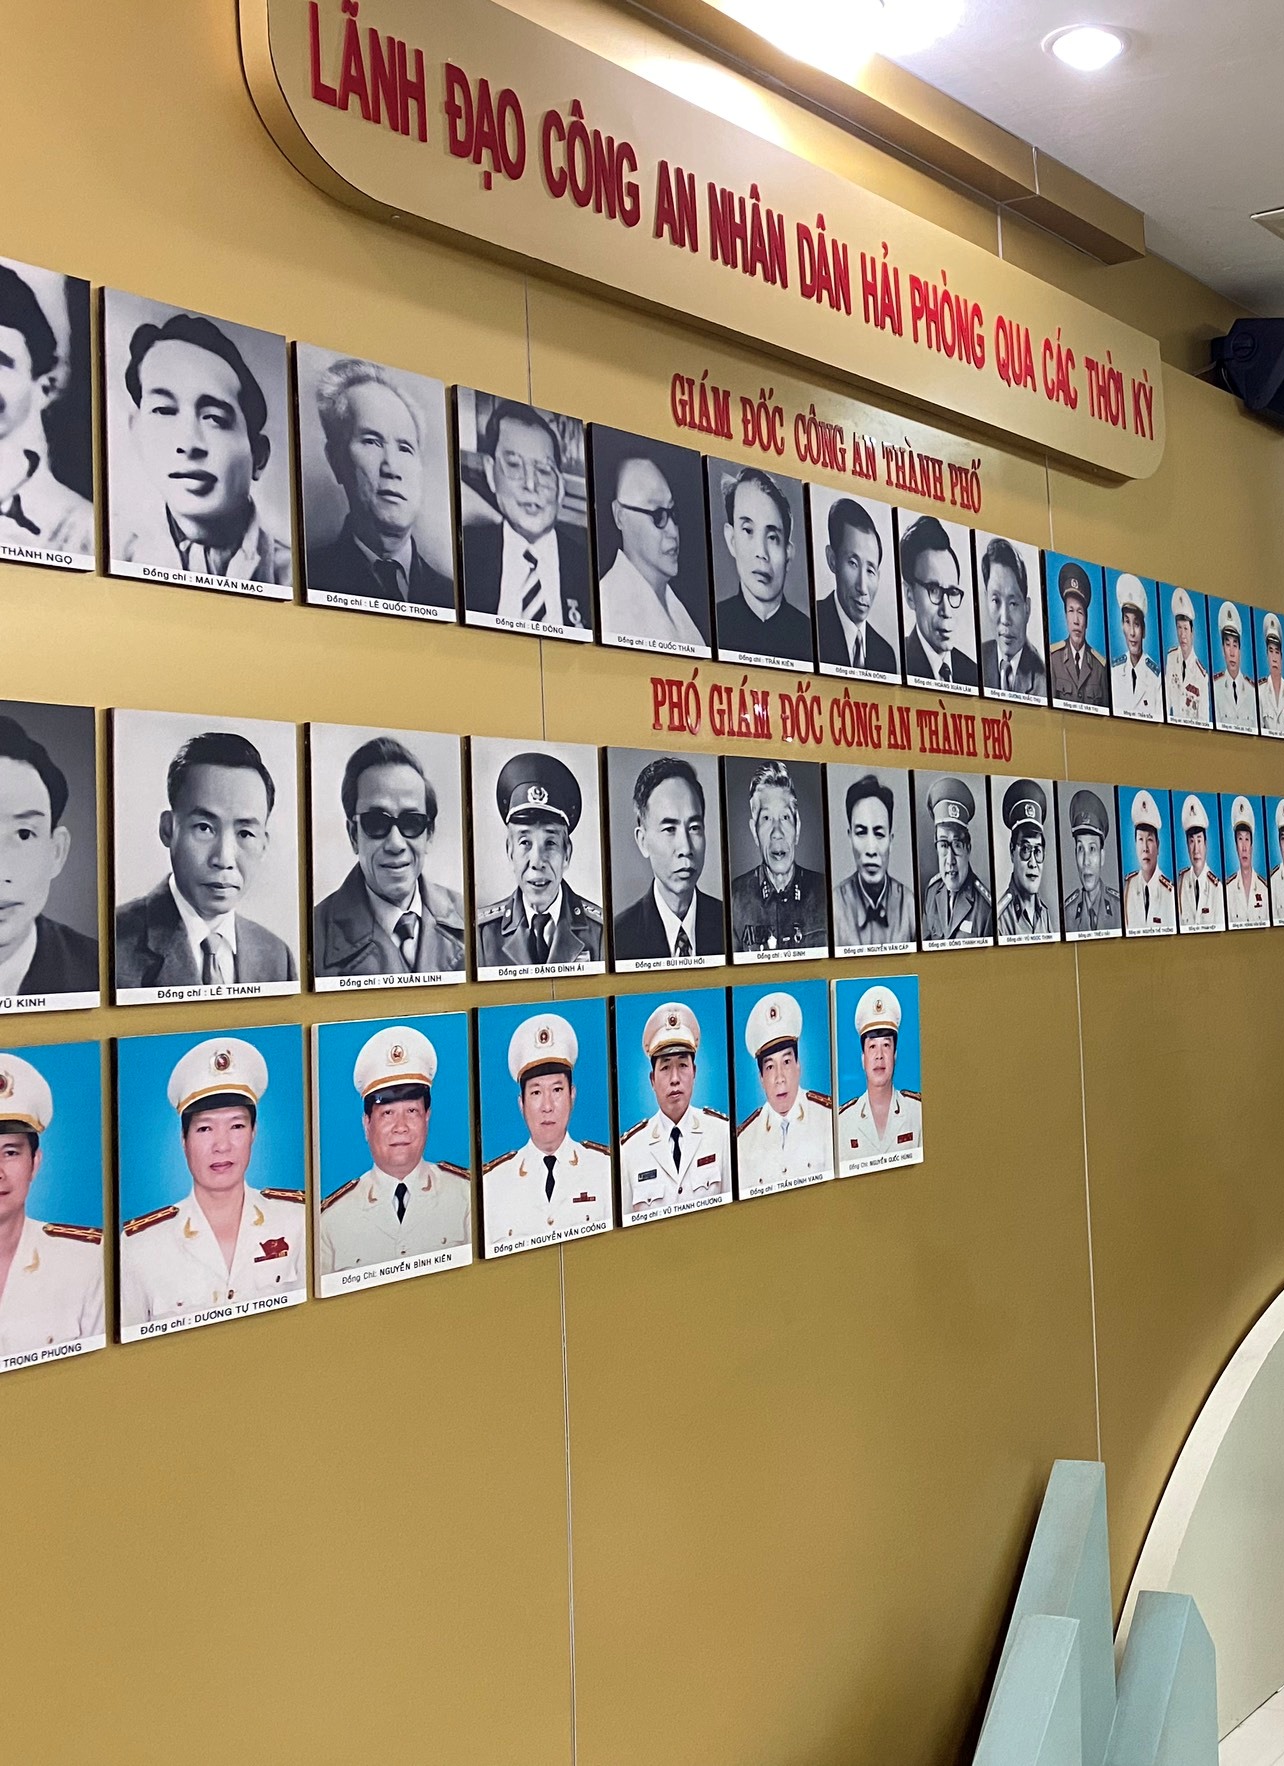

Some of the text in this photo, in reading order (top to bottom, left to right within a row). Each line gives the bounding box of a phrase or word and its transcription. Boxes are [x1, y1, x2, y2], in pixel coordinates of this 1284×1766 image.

[308, 0, 1154, 441] LÃNH ĐẠO CÔNG AN NHÂN DÂN HẢI PHÒNG QUA CÁC THỜI KỲ
[670, 369, 982, 514] GIÁM ĐỐC CÔNG AN THÀNH PHỐ
[1, 545, 42, 560] THÀNH
[195, 575, 214, 585] MAI
[216, 577, 238, 589] VĂN
[241, 582, 263, 593] MẠC
[369, 599, 379, 609] LÊ
[382, 600, 407, 613] QUỐC
[409, 605, 438, 617] TRỌNG
[531, 622, 540, 631] LÊ
[648, 639, 656, 648] LÊ
[650, 667, 1013, 762] PHÓ GIÁM ĐỐC CÔNG AN THÀNH PHỐ
[557, 964, 575, 973] ĐÌNH
[382, 975, 395, 984] VŨ
[397, 975, 421, 984] XUÂN
[423, 974, 442, 983] LINH
[210, 986, 222, 996] LÊ
[227, 985, 261, 995] THANH
[17, 997, 46, 1008] KINH
[662, 1206, 672, 1215] VŨ
[673, 1202, 695, 1212] THANH
[530, 1230, 562, 1245] NGUYỄN
[563, 1228, 579, 1238] VĂN
[379, 1261, 411, 1276] NGUYỄN
[413, 1258, 432, 1269] BÌNH
[194, 1307, 232, 1323] DƯƠNG
[252, 1295, 288, 1311] TRỌNG
[3, 1353, 38, 1368] TRỌNG
